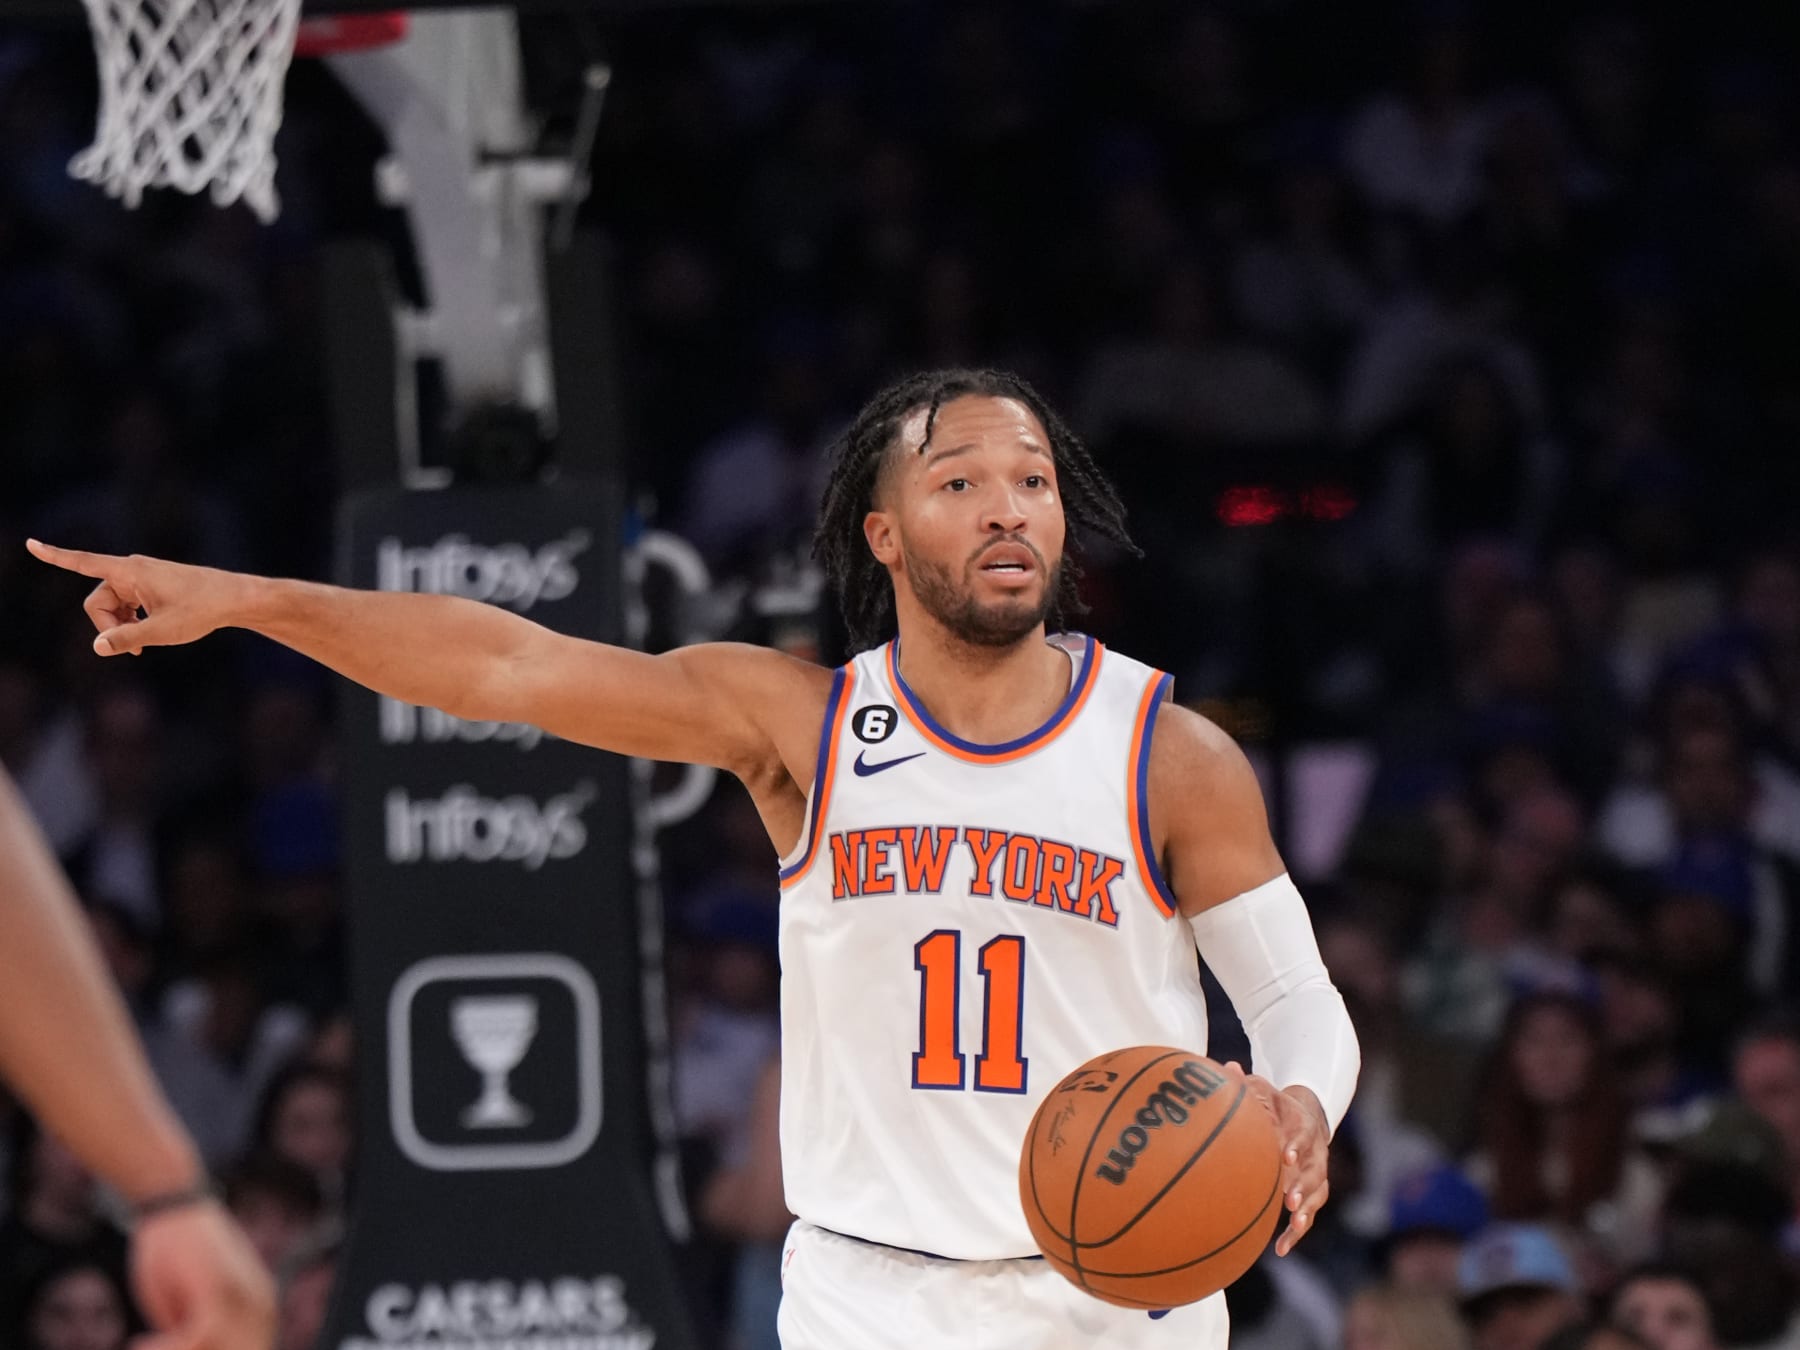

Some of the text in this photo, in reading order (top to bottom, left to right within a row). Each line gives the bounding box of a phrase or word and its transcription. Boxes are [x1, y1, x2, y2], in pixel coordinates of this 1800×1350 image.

[862, 709, 889, 739] 6
[385, 785, 592, 871] Infosys
[829, 825, 1126, 930] NEW YORK
[911, 929, 1029, 1095] 11
[1096, 1061, 1228, 1186] Wilson
[365, 1275, 628, 1342] CAESARS
